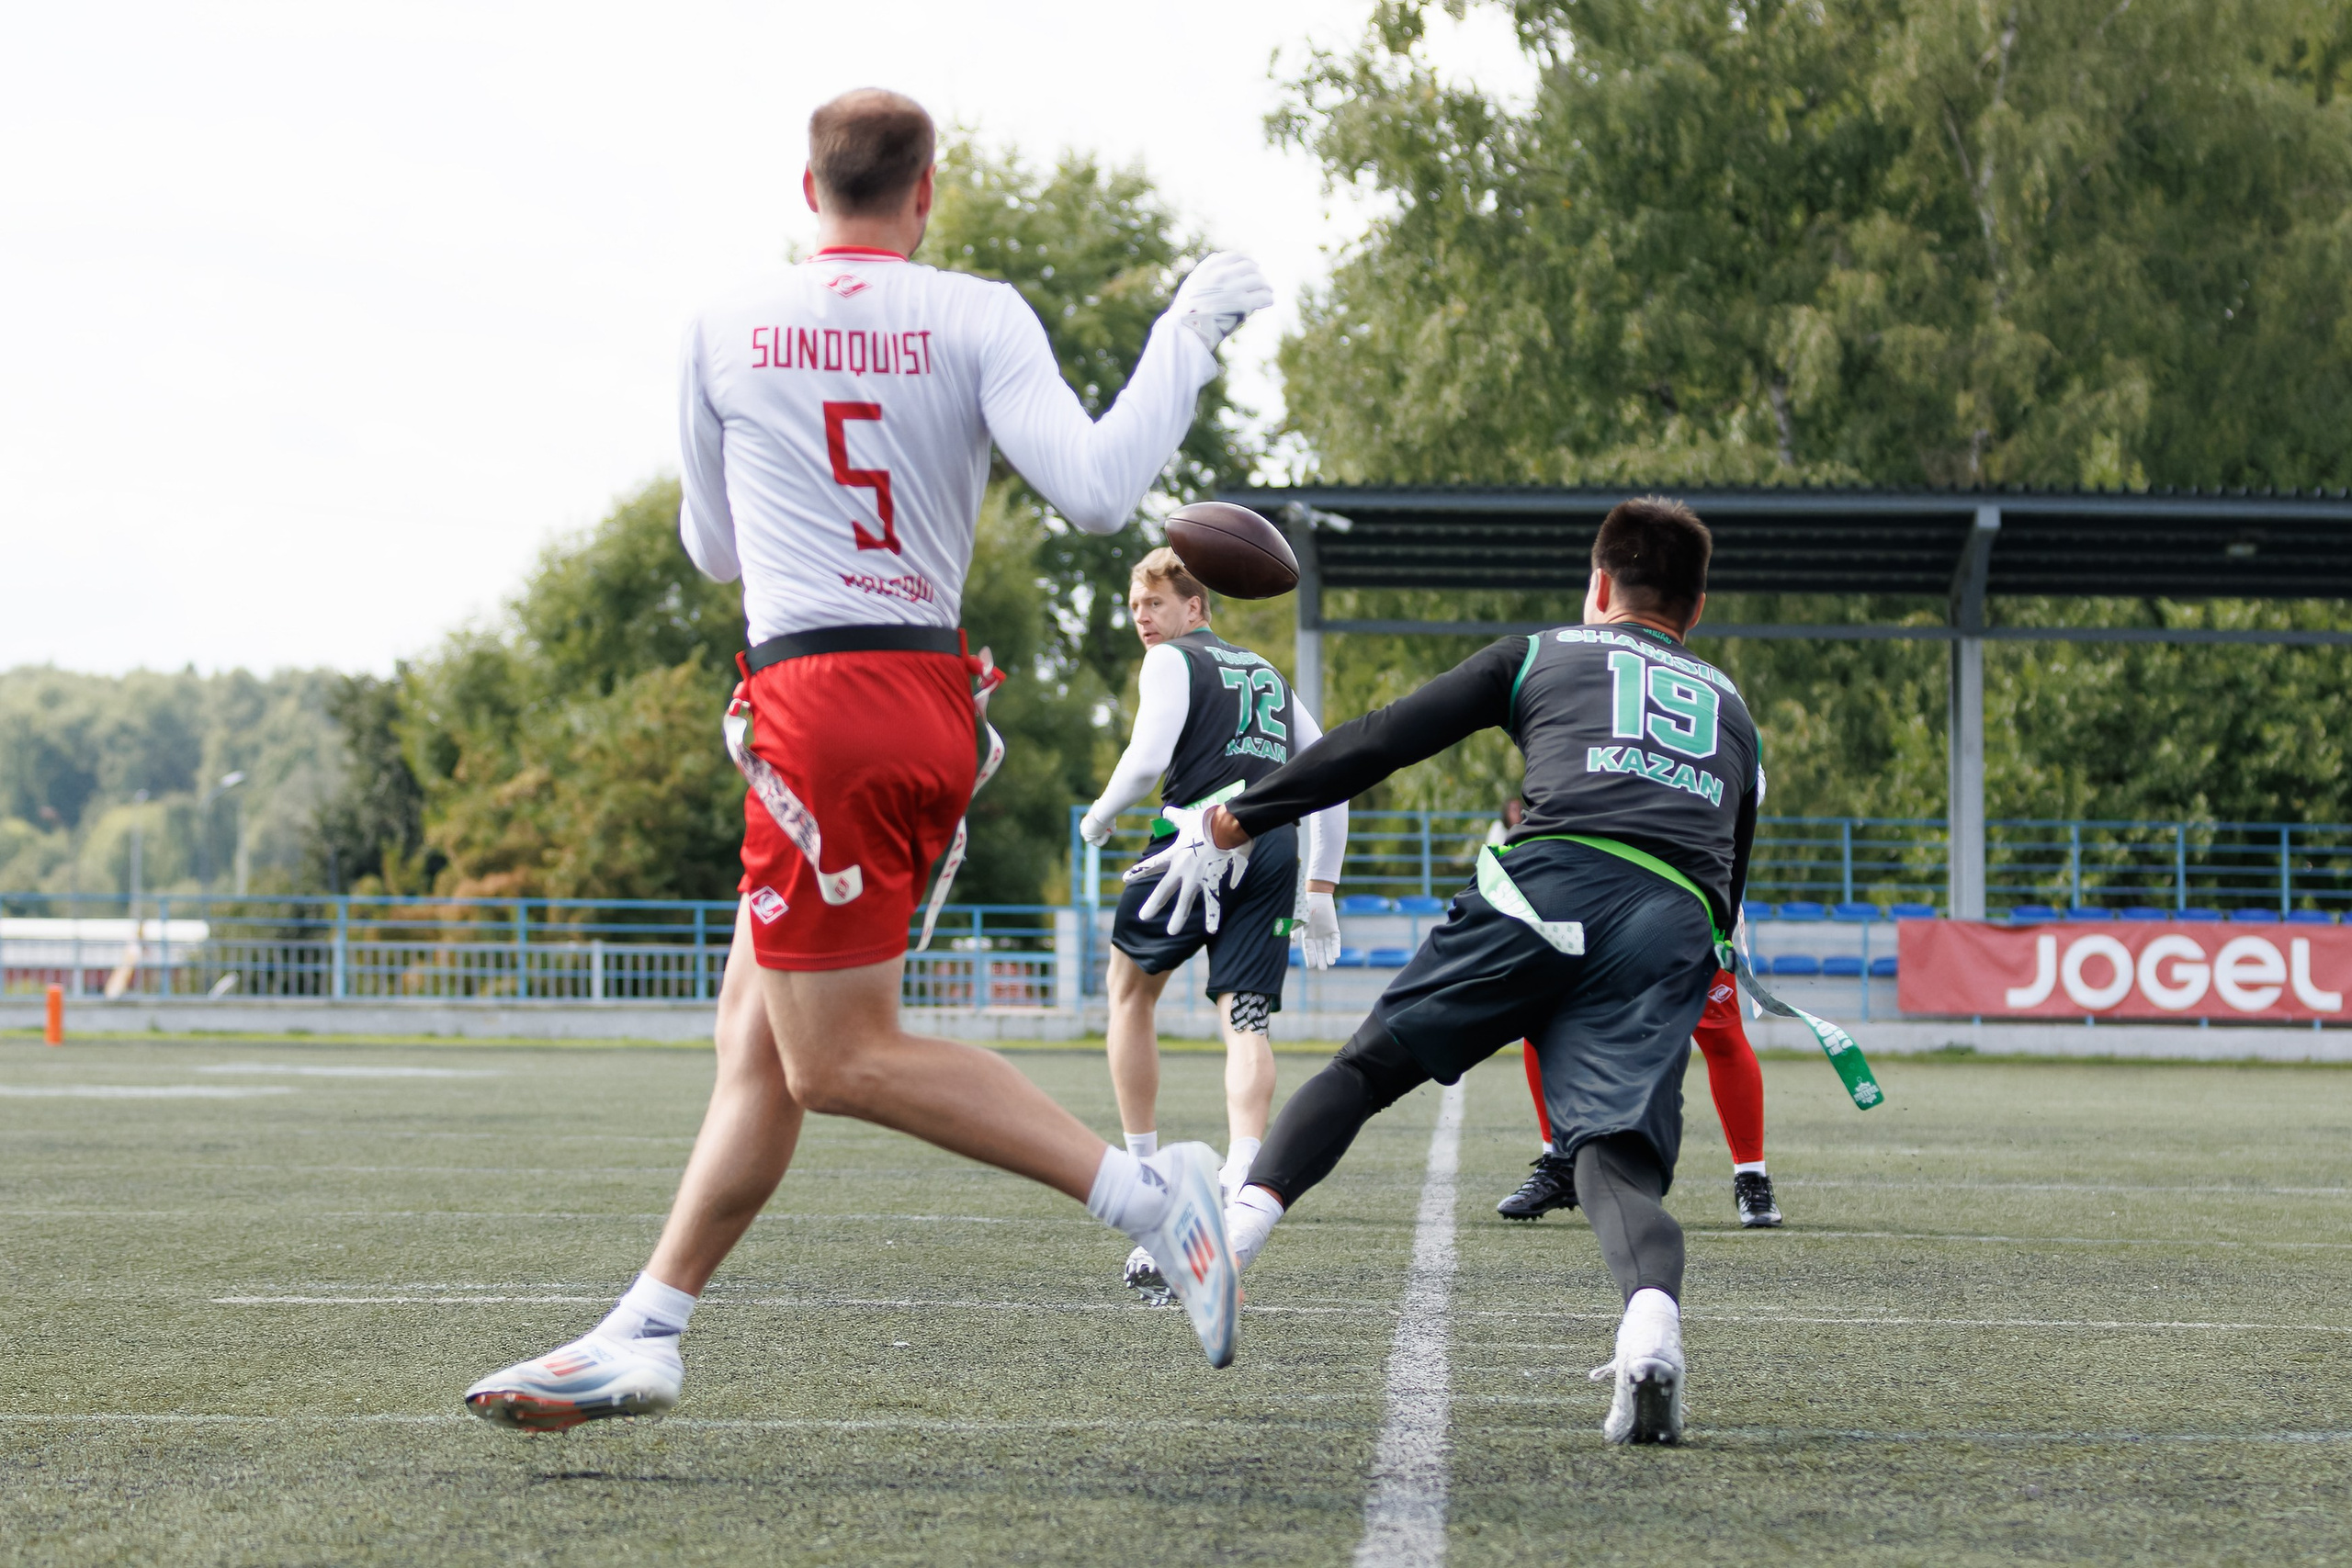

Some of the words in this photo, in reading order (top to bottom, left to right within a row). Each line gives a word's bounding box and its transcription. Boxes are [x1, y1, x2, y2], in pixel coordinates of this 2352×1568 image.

[752, 326, 932, 377] SUNDQUIST
[822, 400, 901, 556] 5
[1218, 666, 1286, 741] 72
[1608, 650, 1720, 760] 19
[1225, 736, 1287, 765] KAZAN
[1586, 746, 1724, 808] KAZAN
